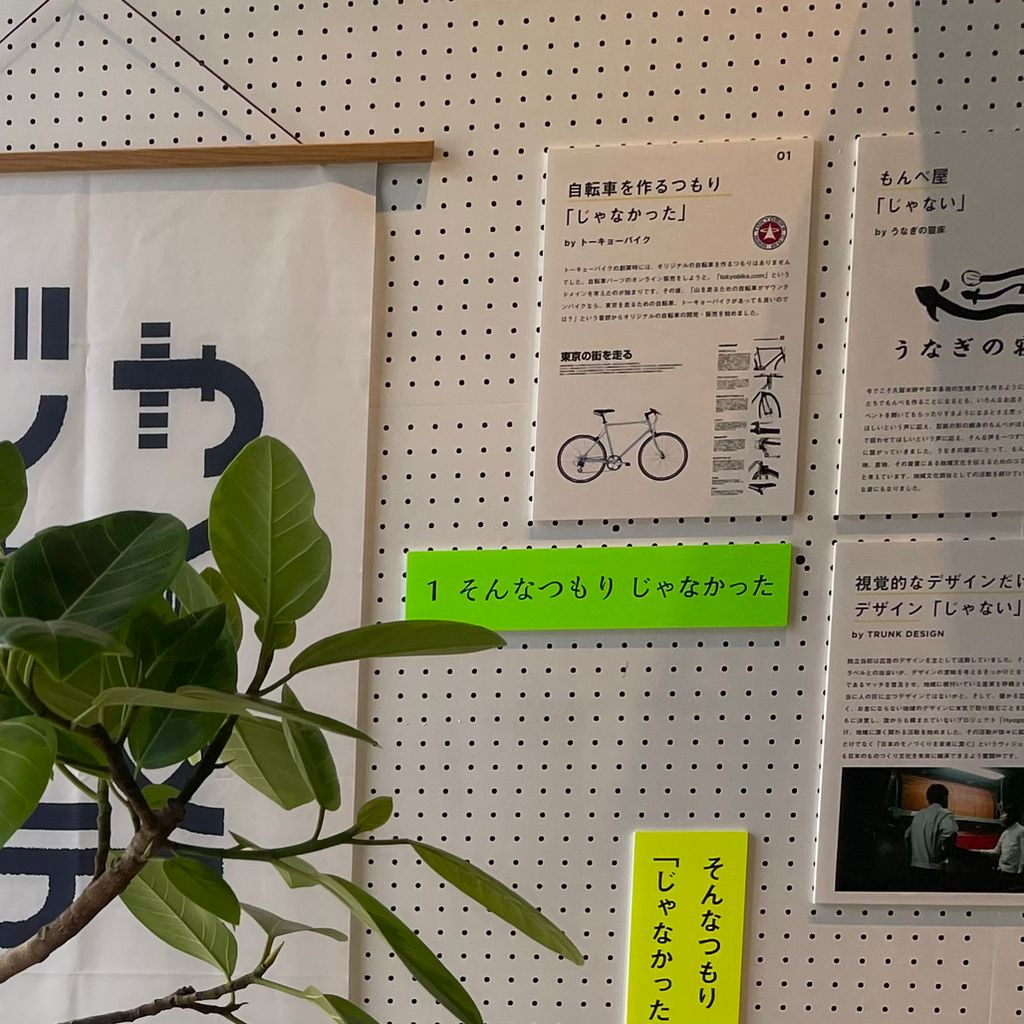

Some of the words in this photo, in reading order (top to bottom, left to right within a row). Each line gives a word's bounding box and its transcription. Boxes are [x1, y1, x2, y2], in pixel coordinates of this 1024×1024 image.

[777, 151, 791, 161] 01
[880, 168, 948, 186] もんぺ屋
[569, 177, 719, 200] 自転車を作るつもり
[877, 194, 965, 215] 「じゃない」
[566, 204, 685, 226] 「じゃなかった」
[874, 228, 887, 237] by
[564, 240, 576, 248] by
[582, 236, 650, 247] トーキョーバイク
[561, 350, 634, 364] 東京の街を走る
[427, 580, 437, 601] 1
[460, 576, 613, 601] そんなつもり
[634, 575, 773, 598] じゃなかった
[855, 600, 1021, 617] デザイン「じゃない」
[852, 631, 864, 640] by
[906, 630, 944, 638] DESIGN
[698, 857, 723, 1009] そんなつもり
